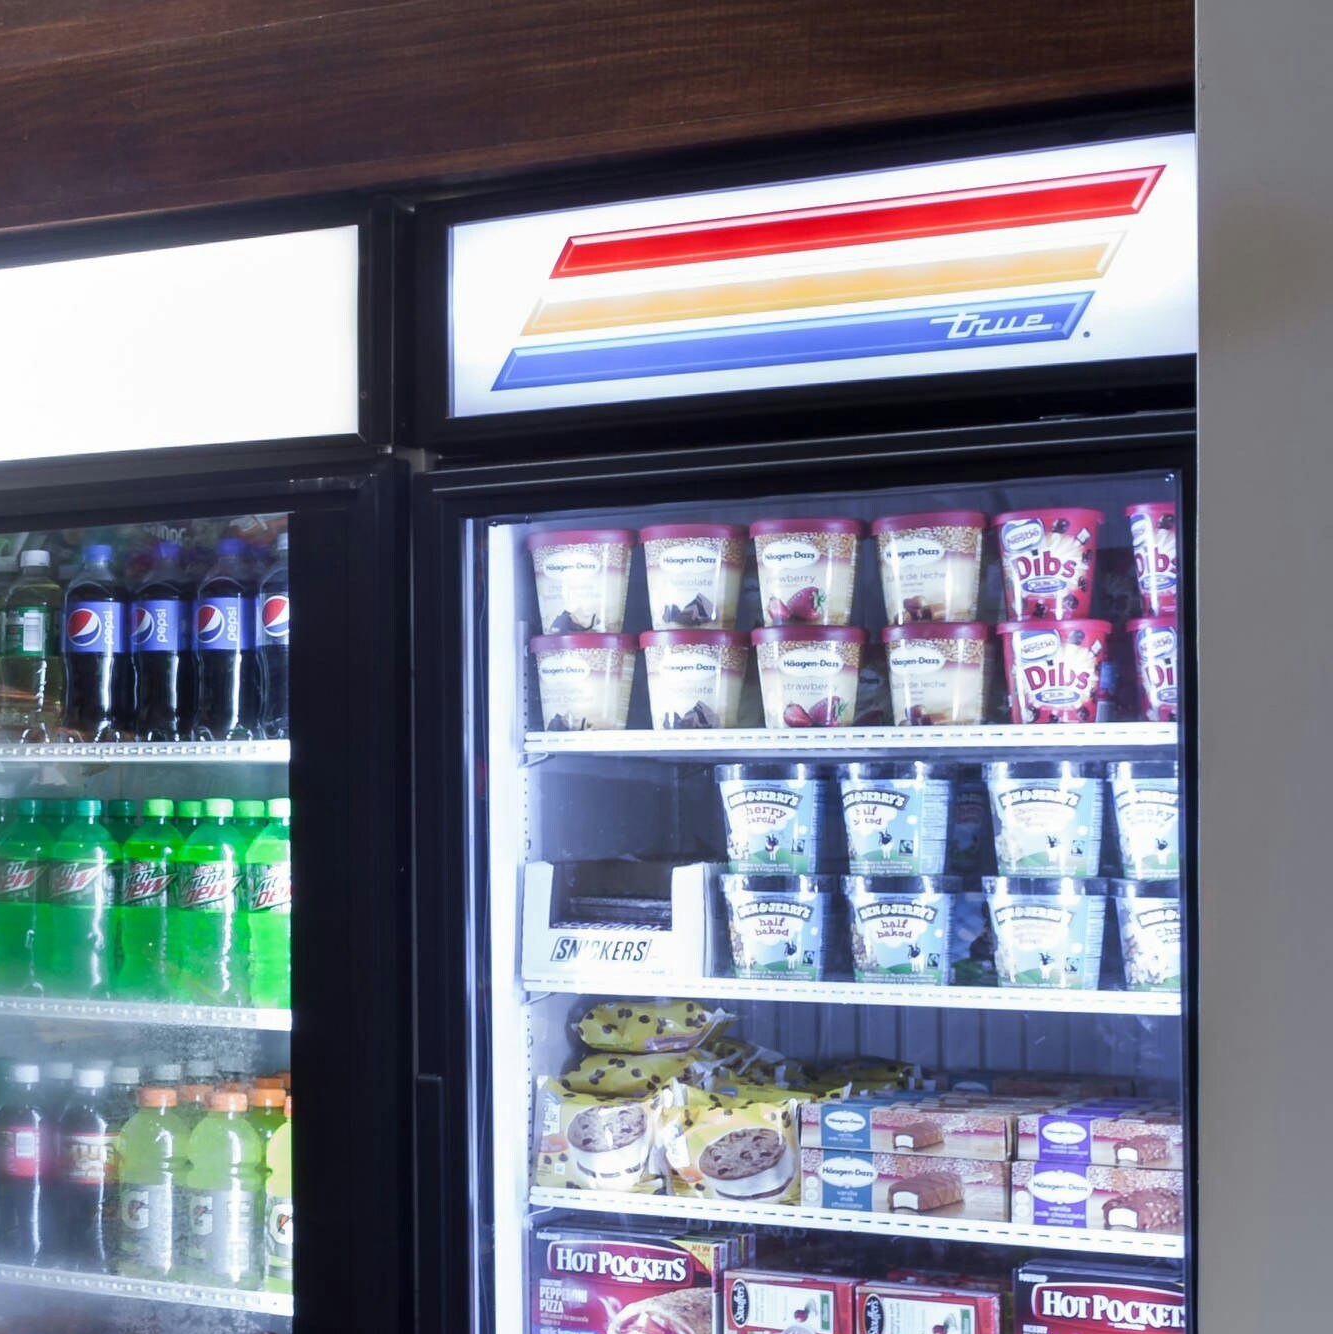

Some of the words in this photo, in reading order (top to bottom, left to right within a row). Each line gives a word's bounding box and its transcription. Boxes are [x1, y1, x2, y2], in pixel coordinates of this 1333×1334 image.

[1015, 550, 1078, 580] Dibs
[156, 607, 169, 644] pepsi
[226, 605, 238, 643] pepsi
[1024, 660, 1091, 691] Dibs
[759, 917, 785, 927] half
[881, 918, 907, 929] half
[756, 927, 789, 937] baked
[877, 928, 912, 939] baked
[822, 1165, 874, 1179] Häagen-Dazs
[556, 1248, 598, 1273] HOT
[598, 1253, 688, 1283] POCKETS
[539, 1287, 588, 1303] PEPPERONI
[539, 1300, 564, 1314] PIZZA
[1042, 1290, 1091, 1318] HOT
